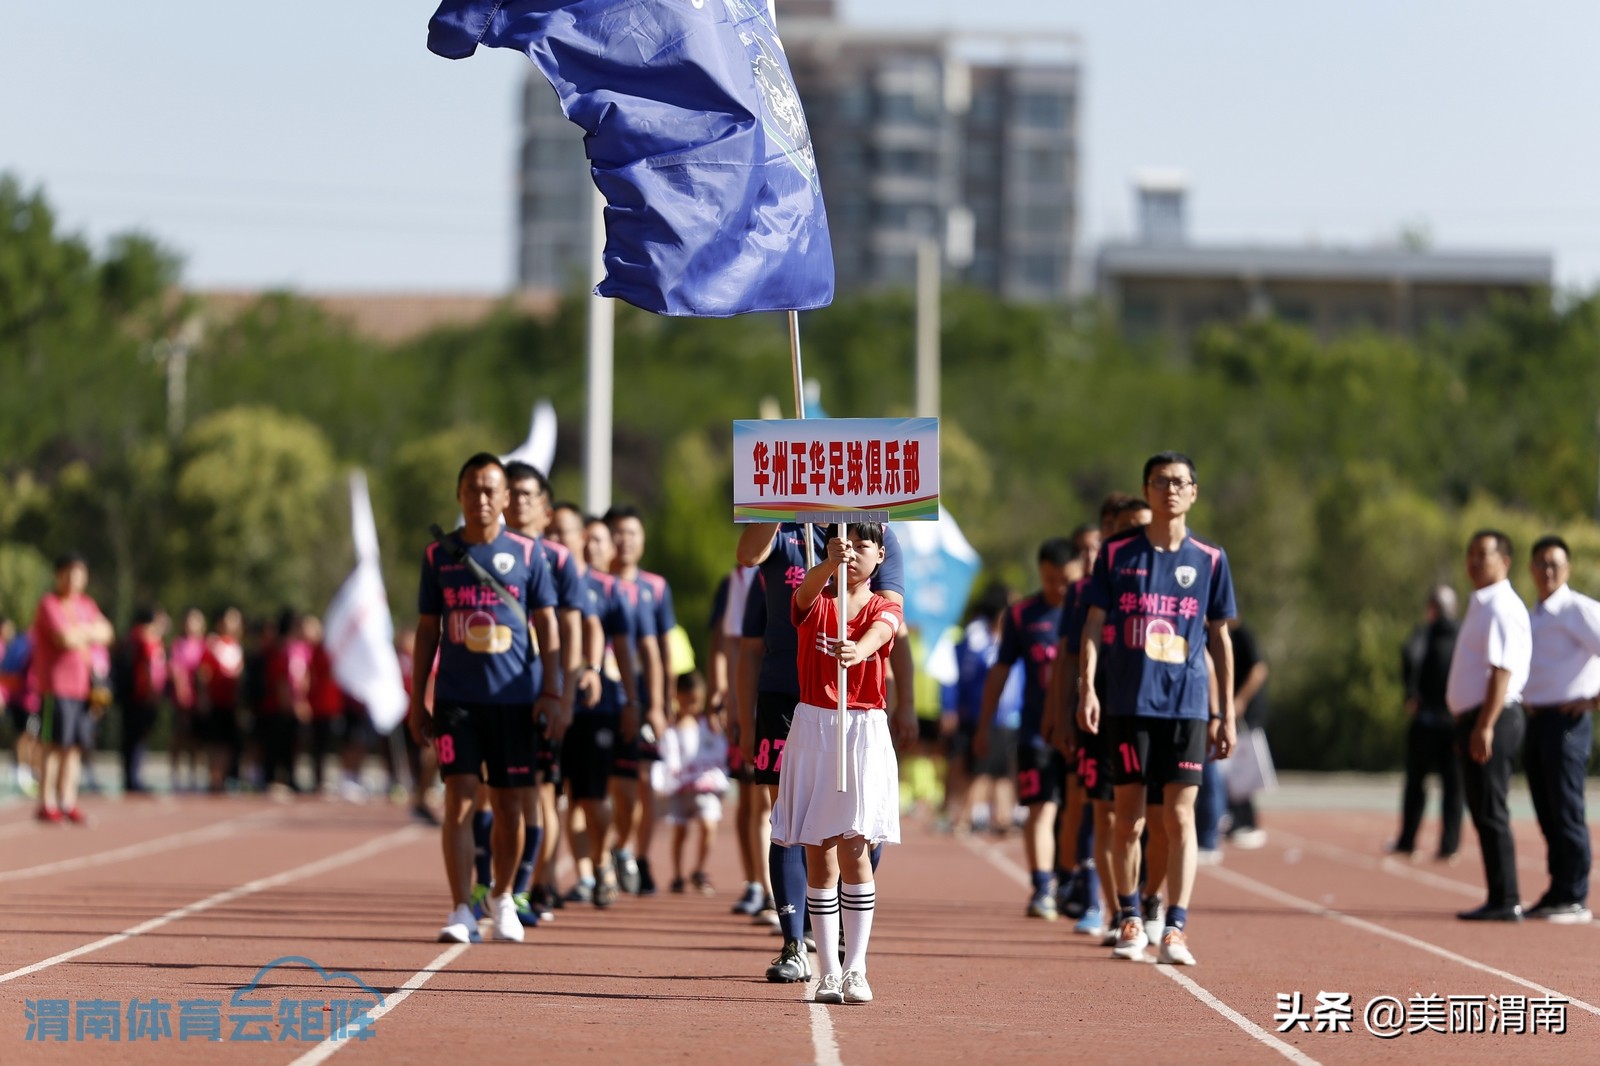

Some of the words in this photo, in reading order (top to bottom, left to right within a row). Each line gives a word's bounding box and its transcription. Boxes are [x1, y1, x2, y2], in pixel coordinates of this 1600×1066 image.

[753, 440, 920, 496] 华州正华足球俱乐部
[1120, 592, 1198, 619] 华州正华
[436, 733, 455, 764] 8
